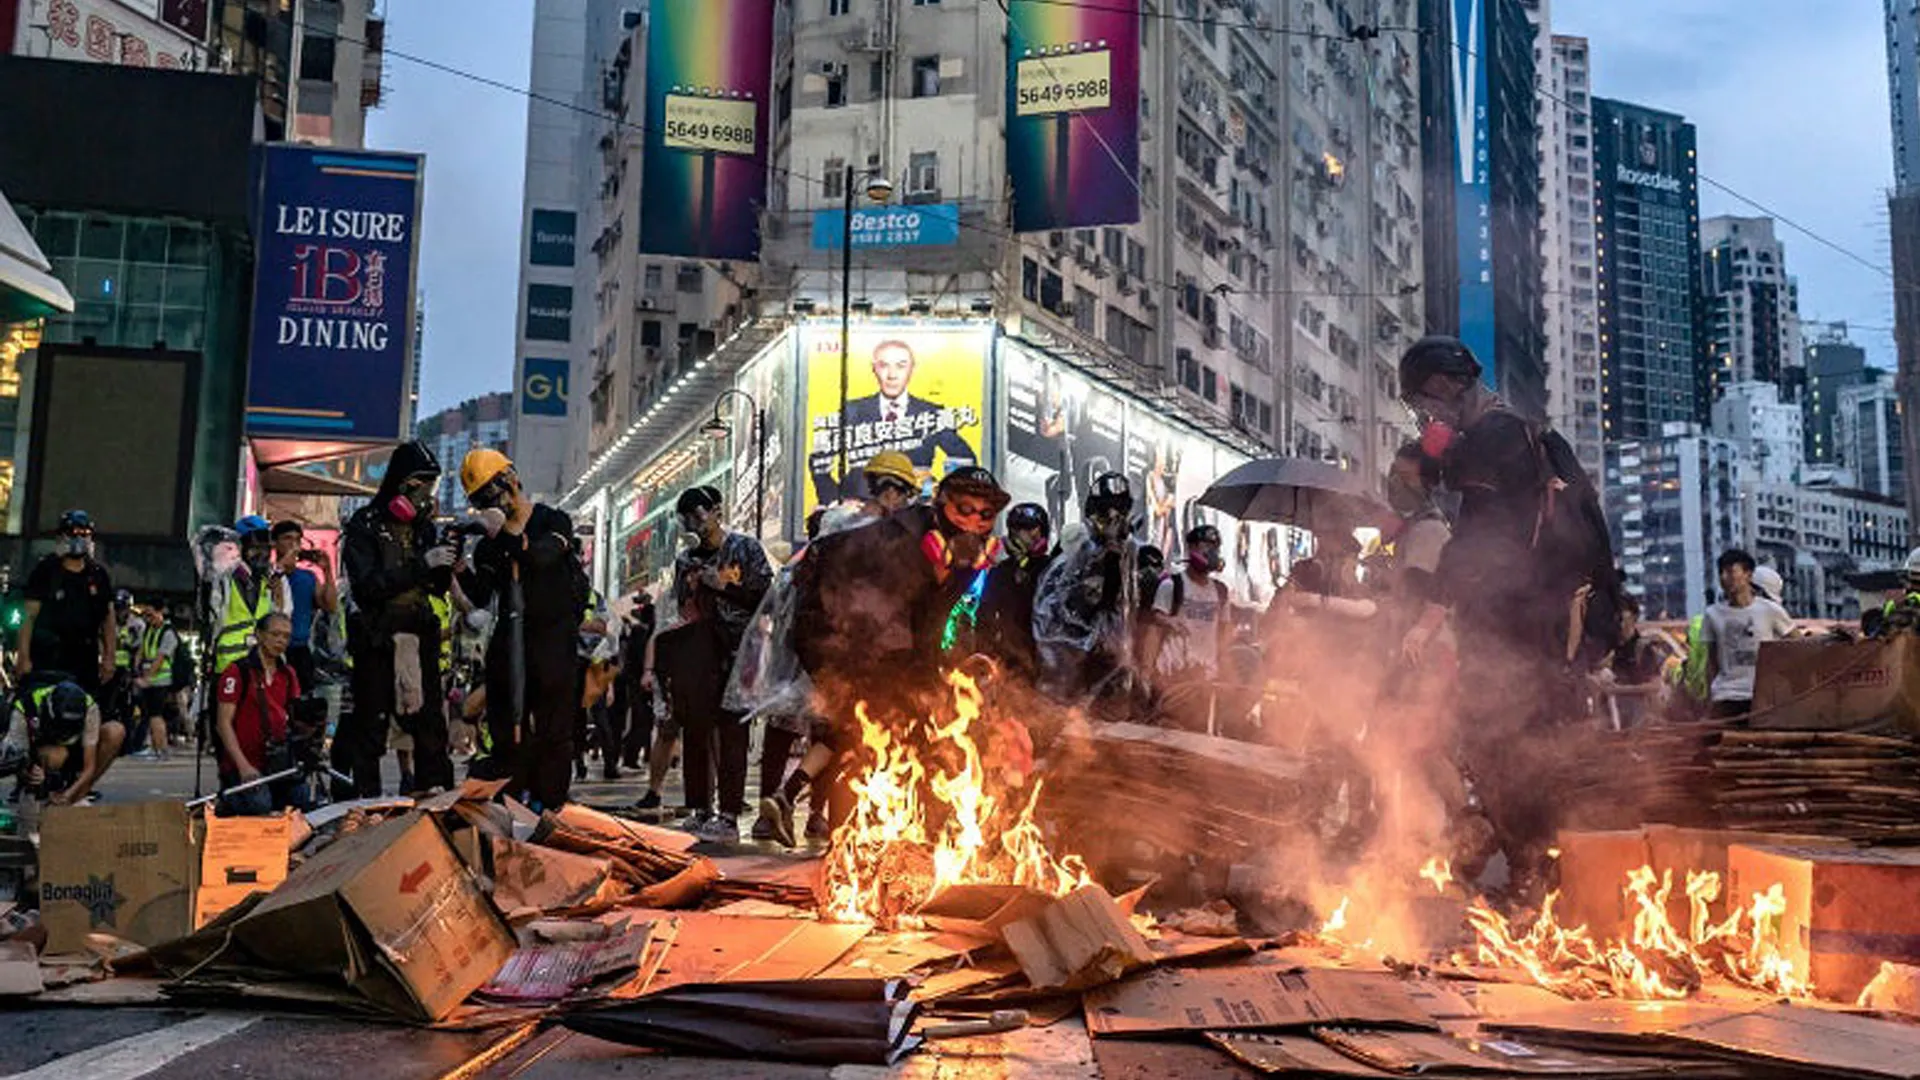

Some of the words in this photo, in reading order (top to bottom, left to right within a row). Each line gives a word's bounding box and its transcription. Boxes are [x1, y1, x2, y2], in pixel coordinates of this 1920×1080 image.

[276, 204, 405, 242] LEISURE
[850, 212, 921, 231] Bestco
[277, 315, 389, 351] DINING
[224, 677, 236, 694] 3
